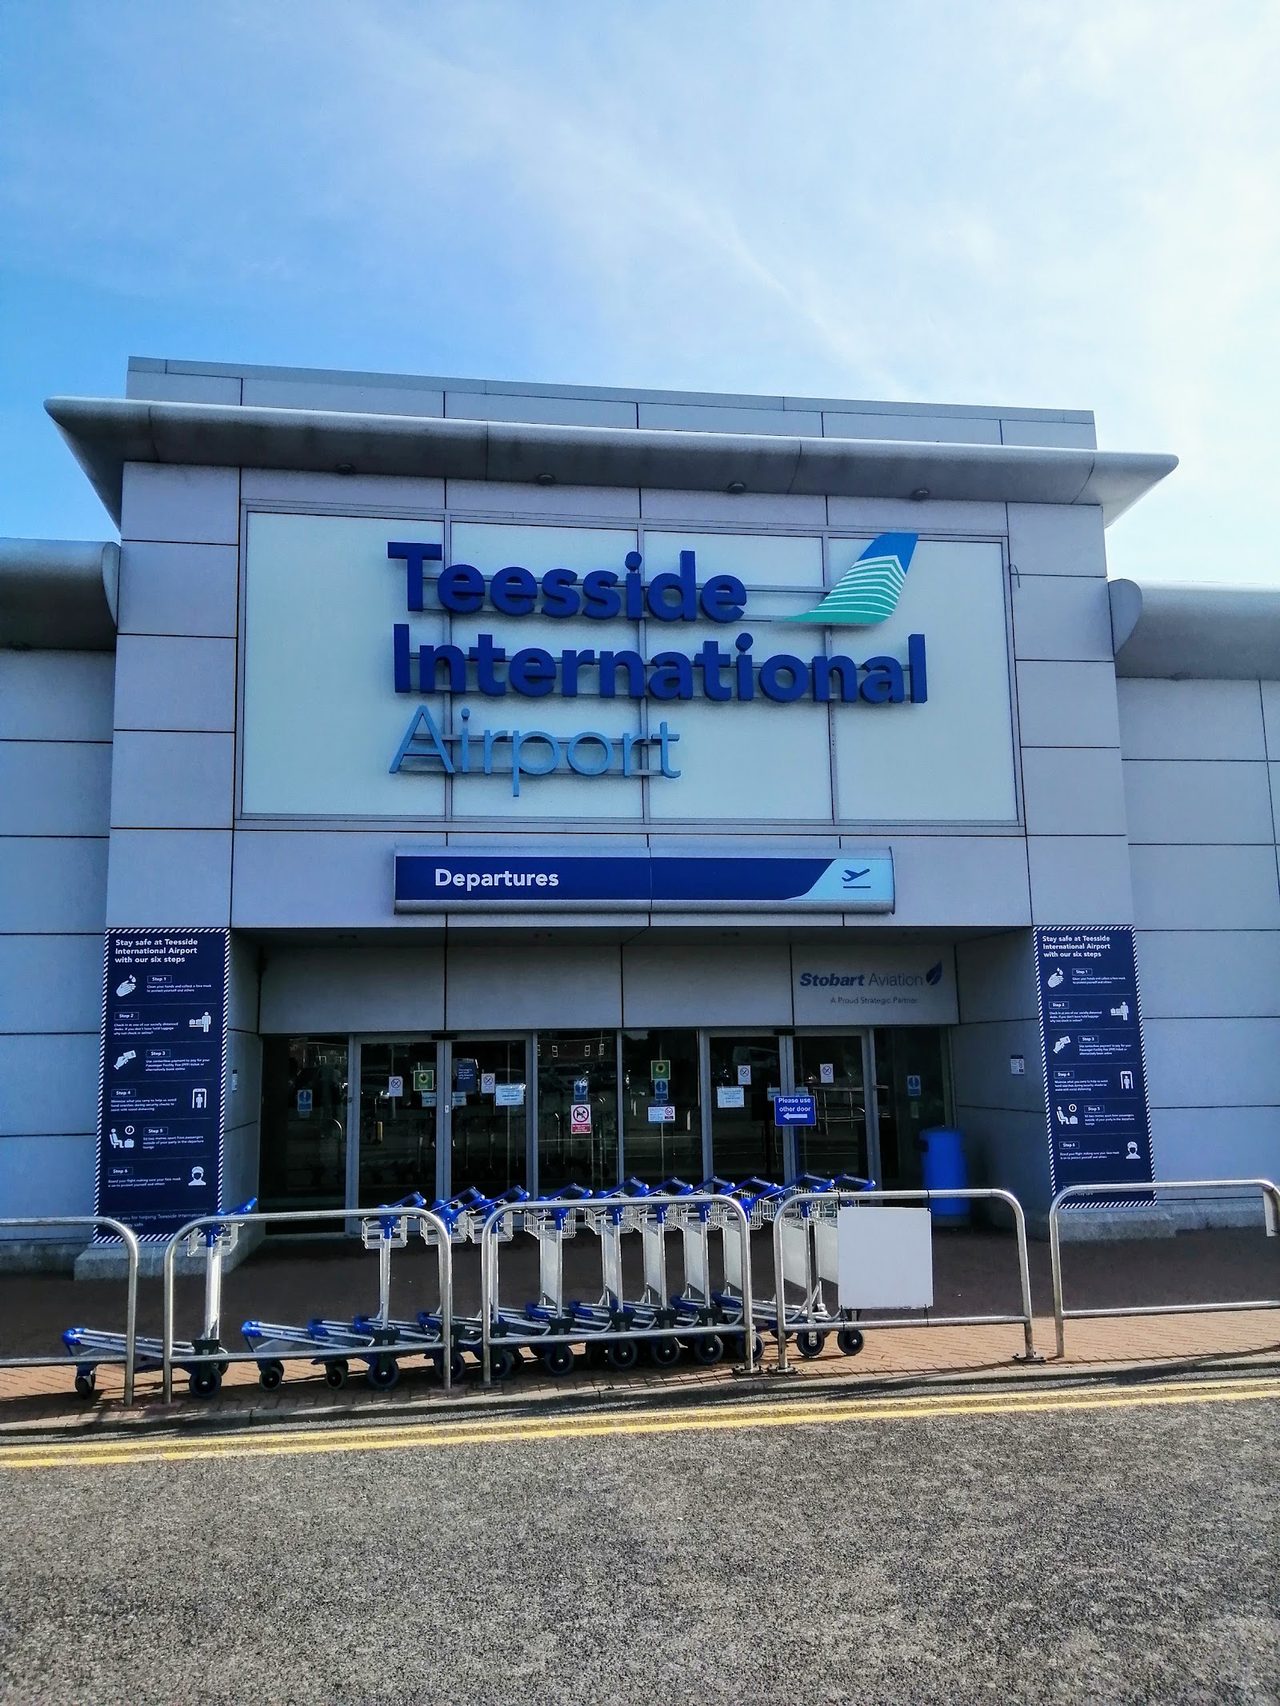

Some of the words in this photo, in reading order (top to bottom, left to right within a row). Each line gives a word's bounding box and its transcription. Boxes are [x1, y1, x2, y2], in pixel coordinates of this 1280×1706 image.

[387, 542, 747, 623] Teesside
[393, 623, 927, 704] International
[389, 705, 681, 797] Airport
[435, 868, 559, 891] Departures
[115, 939, 133, 947] Stay
[1042, 936, 1057, 944] Stay
[168, 947, 198, 955] Airport
[164, 956, 185, 964] steps
[800, 973, 865, 987] Stobart
[868, 973, 923, 986] Aviation
